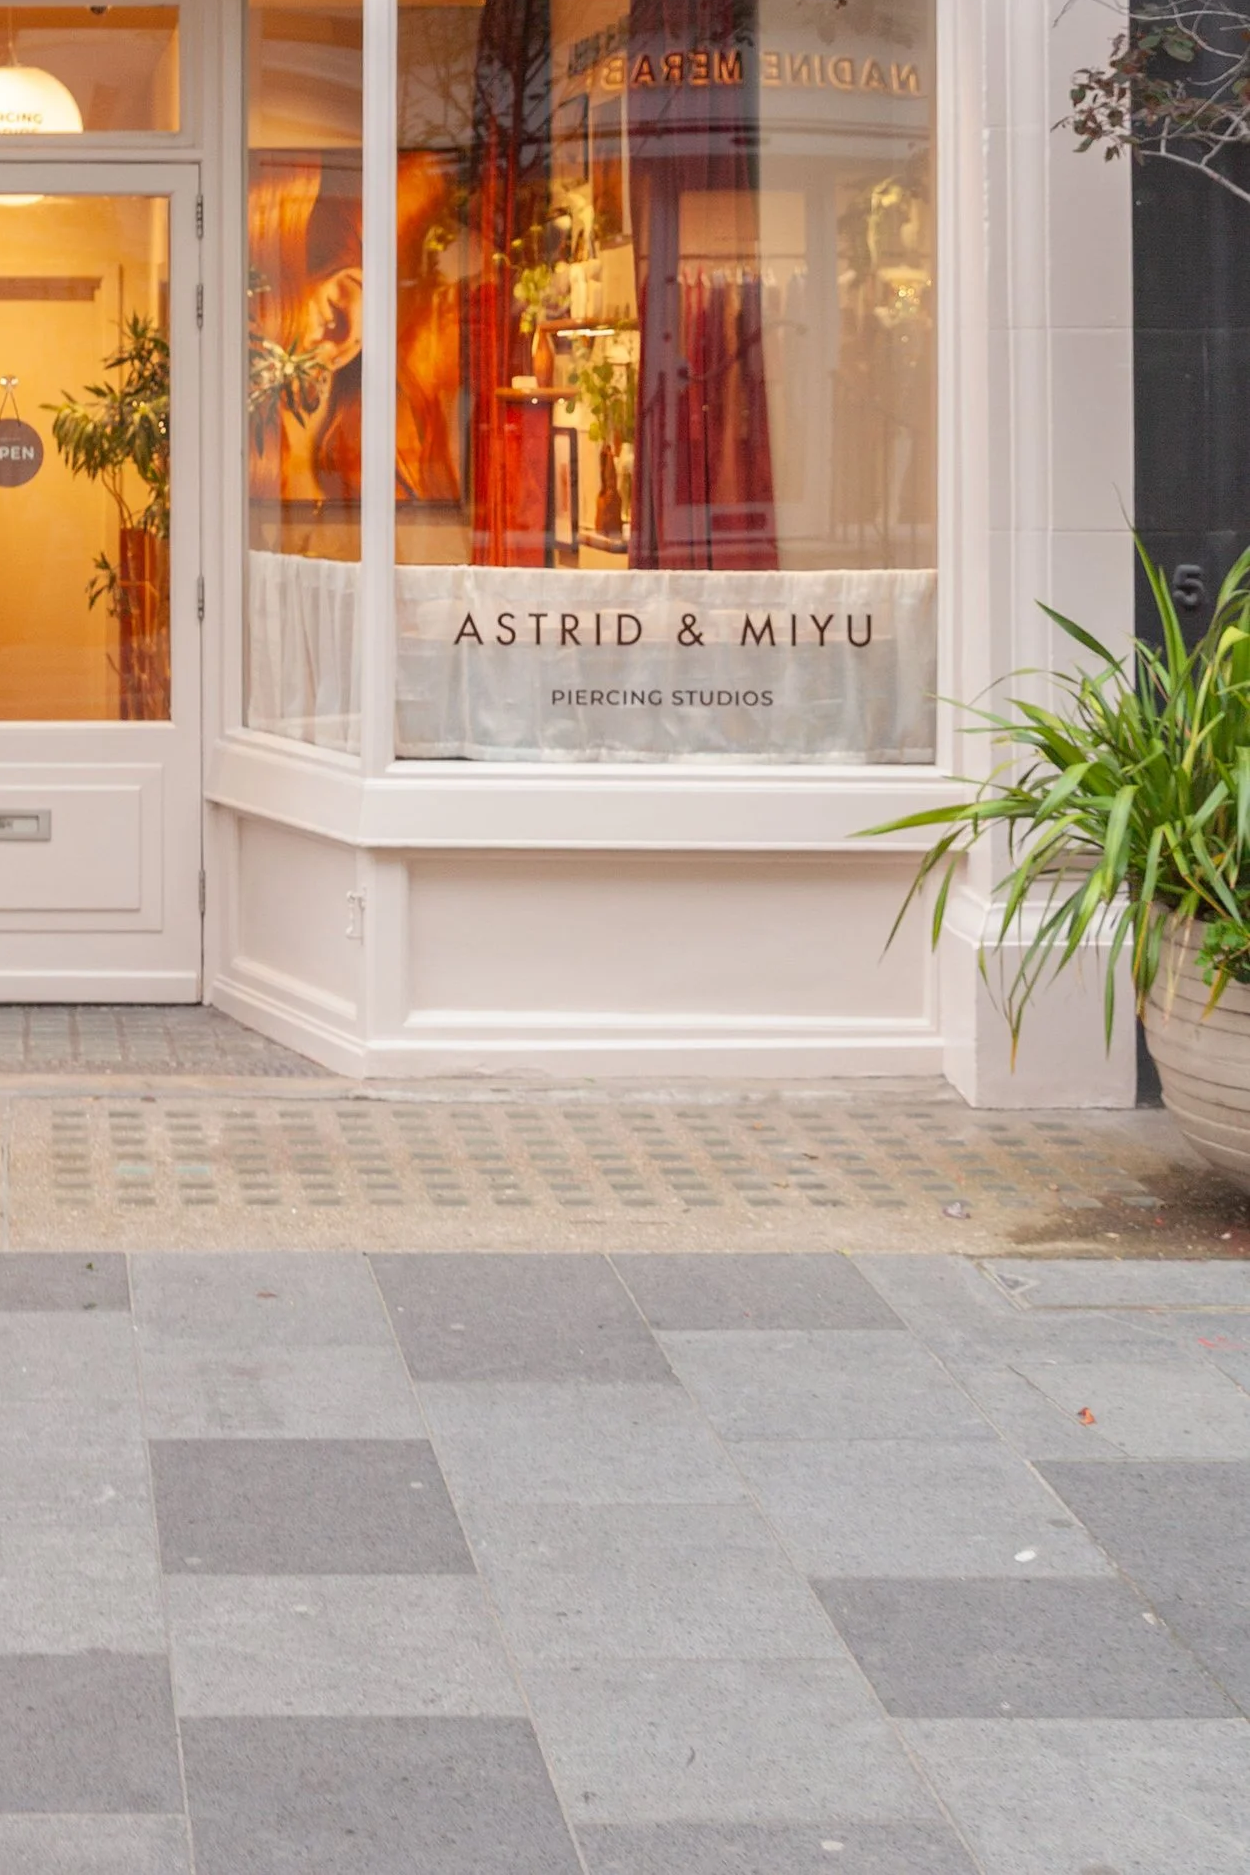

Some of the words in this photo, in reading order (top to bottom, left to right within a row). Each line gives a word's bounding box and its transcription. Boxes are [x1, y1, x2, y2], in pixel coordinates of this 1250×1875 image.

[1172, 564, 1205, 606] 5
[453, 612, 643, 646] ASTRID
[676, 613, 705, 646] &
[740, 612, 873, 647] MIYU
[551, 689, 663, 706] PIERCING
[671, 689, 774, 707] STUDIOS
